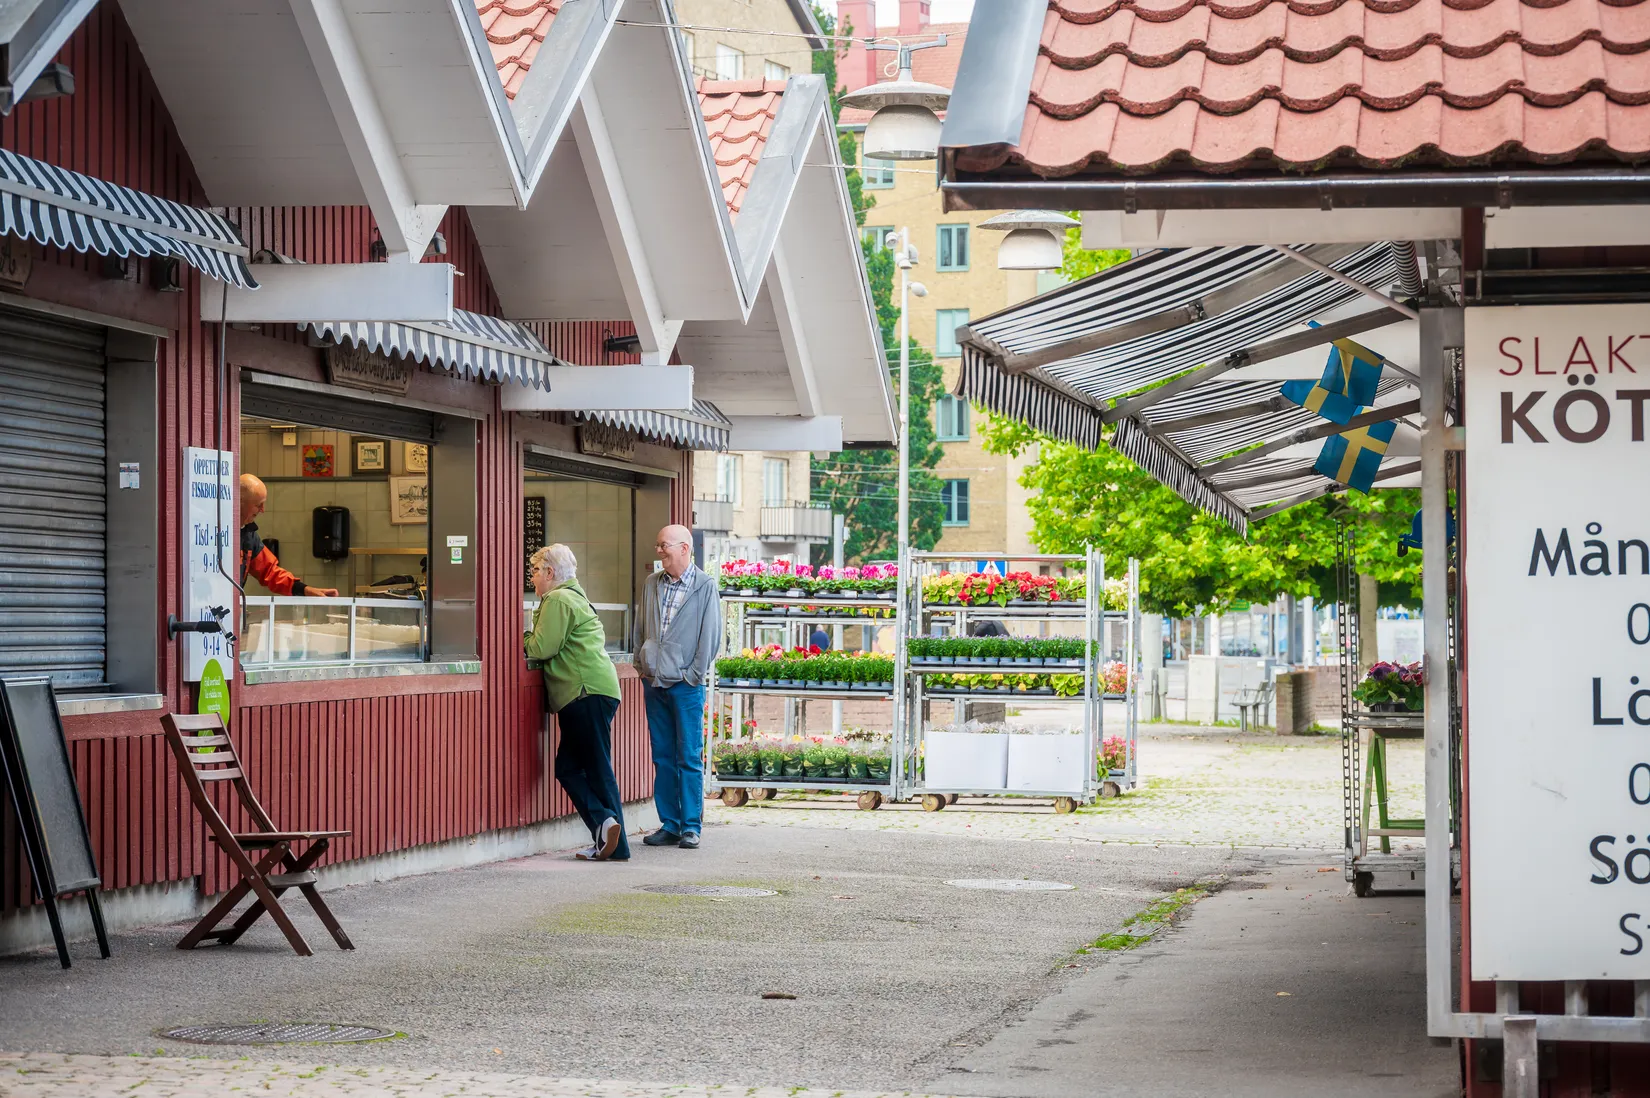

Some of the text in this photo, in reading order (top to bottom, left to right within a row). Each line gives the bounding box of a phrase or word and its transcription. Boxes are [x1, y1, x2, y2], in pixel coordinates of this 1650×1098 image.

[194, 523, 209, 546] Tisd
[1528, 522, 1650, 577] Mån
[1619, 912, 1650, 956] S
